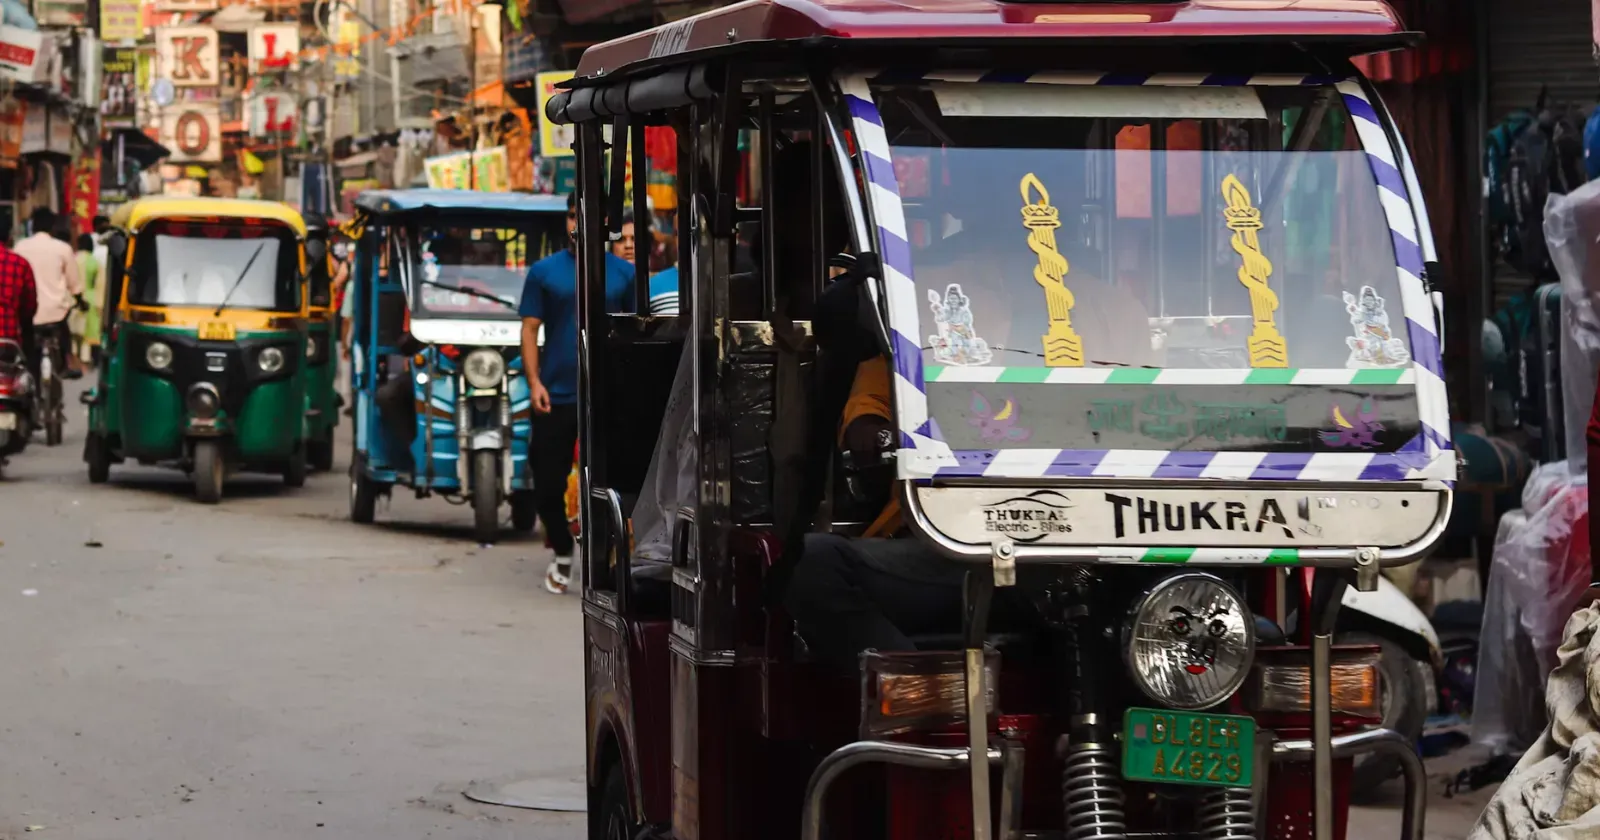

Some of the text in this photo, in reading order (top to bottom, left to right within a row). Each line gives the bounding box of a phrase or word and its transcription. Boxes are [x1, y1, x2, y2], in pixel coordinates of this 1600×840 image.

[171, 35, 210, 79] K
[262, 33, 291, 68] L
[264, 97, 293, 131] L
[176, 110, 209, 156] O
[985, 520, 1029, 532] Electric
[1151, 714, 1241, 749] DL8ER
[1152, 748, 1242, 782] A4829
